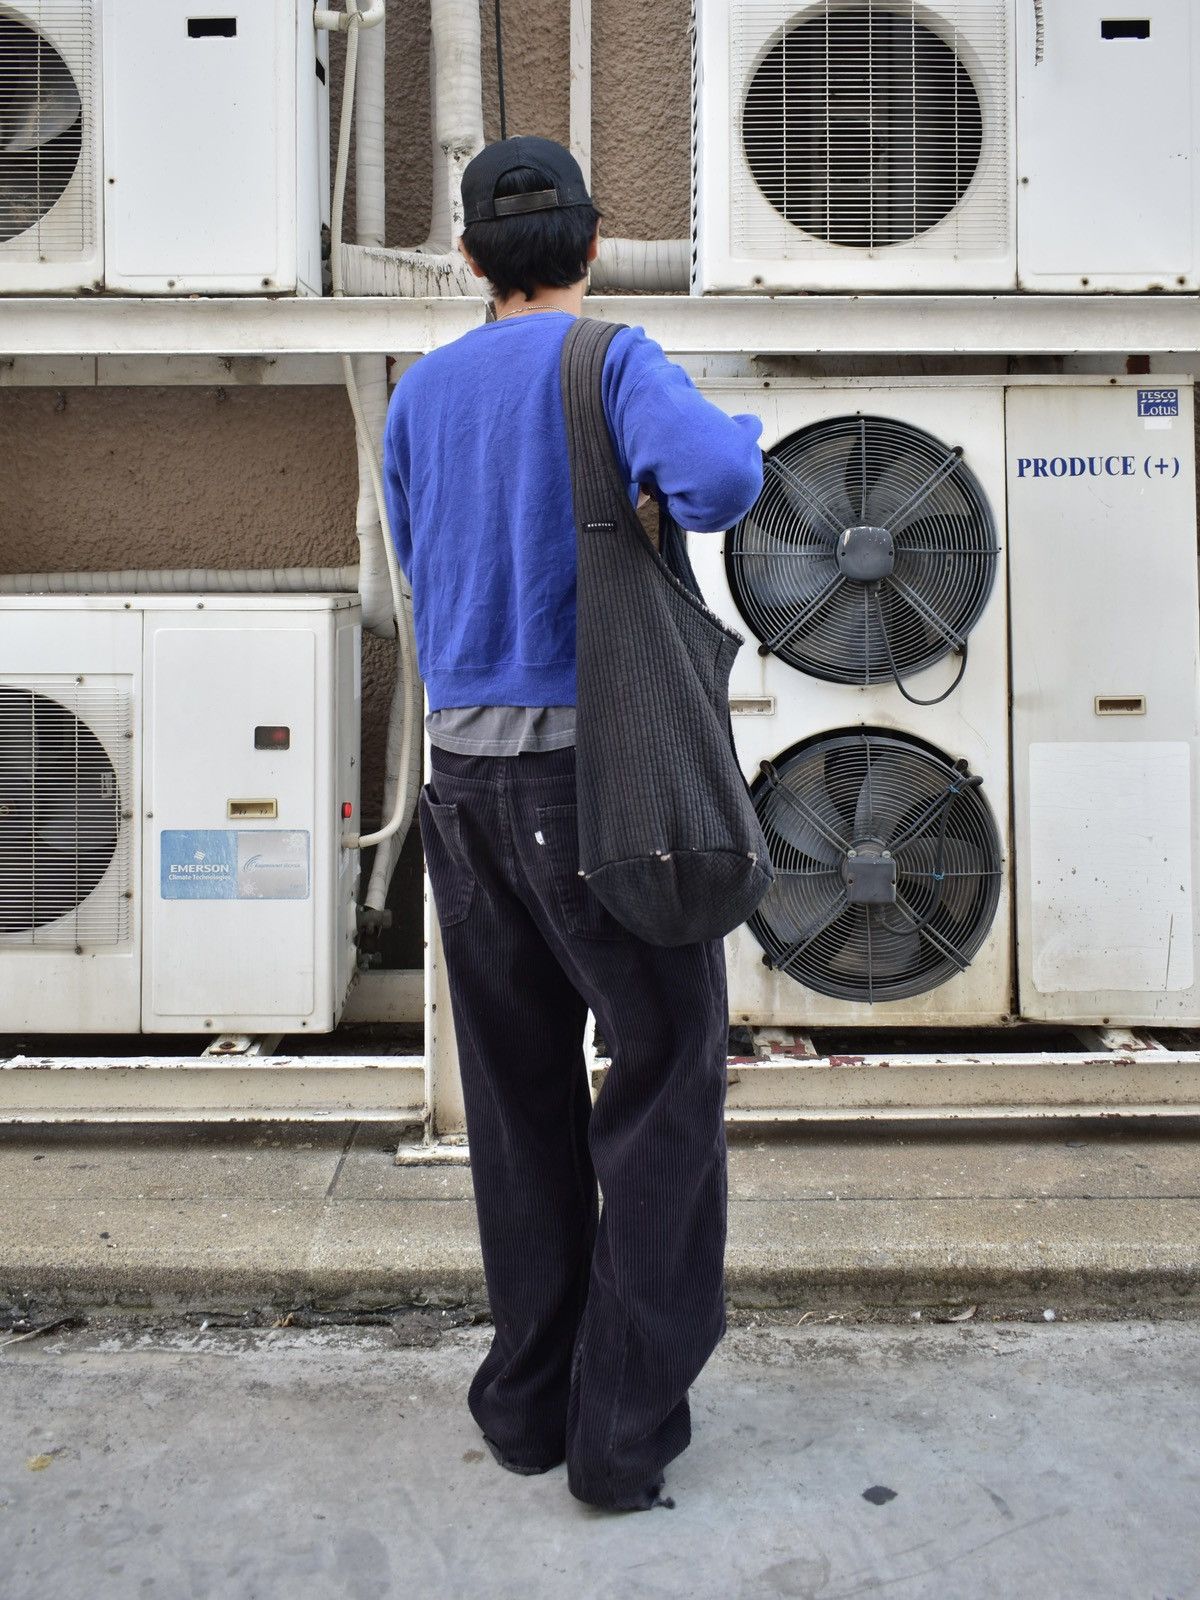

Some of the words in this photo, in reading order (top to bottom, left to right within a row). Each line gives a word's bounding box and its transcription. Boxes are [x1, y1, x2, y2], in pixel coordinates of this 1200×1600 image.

[1140, 391, 1176, 399] TESCO
[1140, 404, 1178, 416] Lotus
[1017, 456, 1136, 478] PRODUCE
[1143, 456, 1180, 478] (+)
[170, 864, 230, 873] EMERSON
